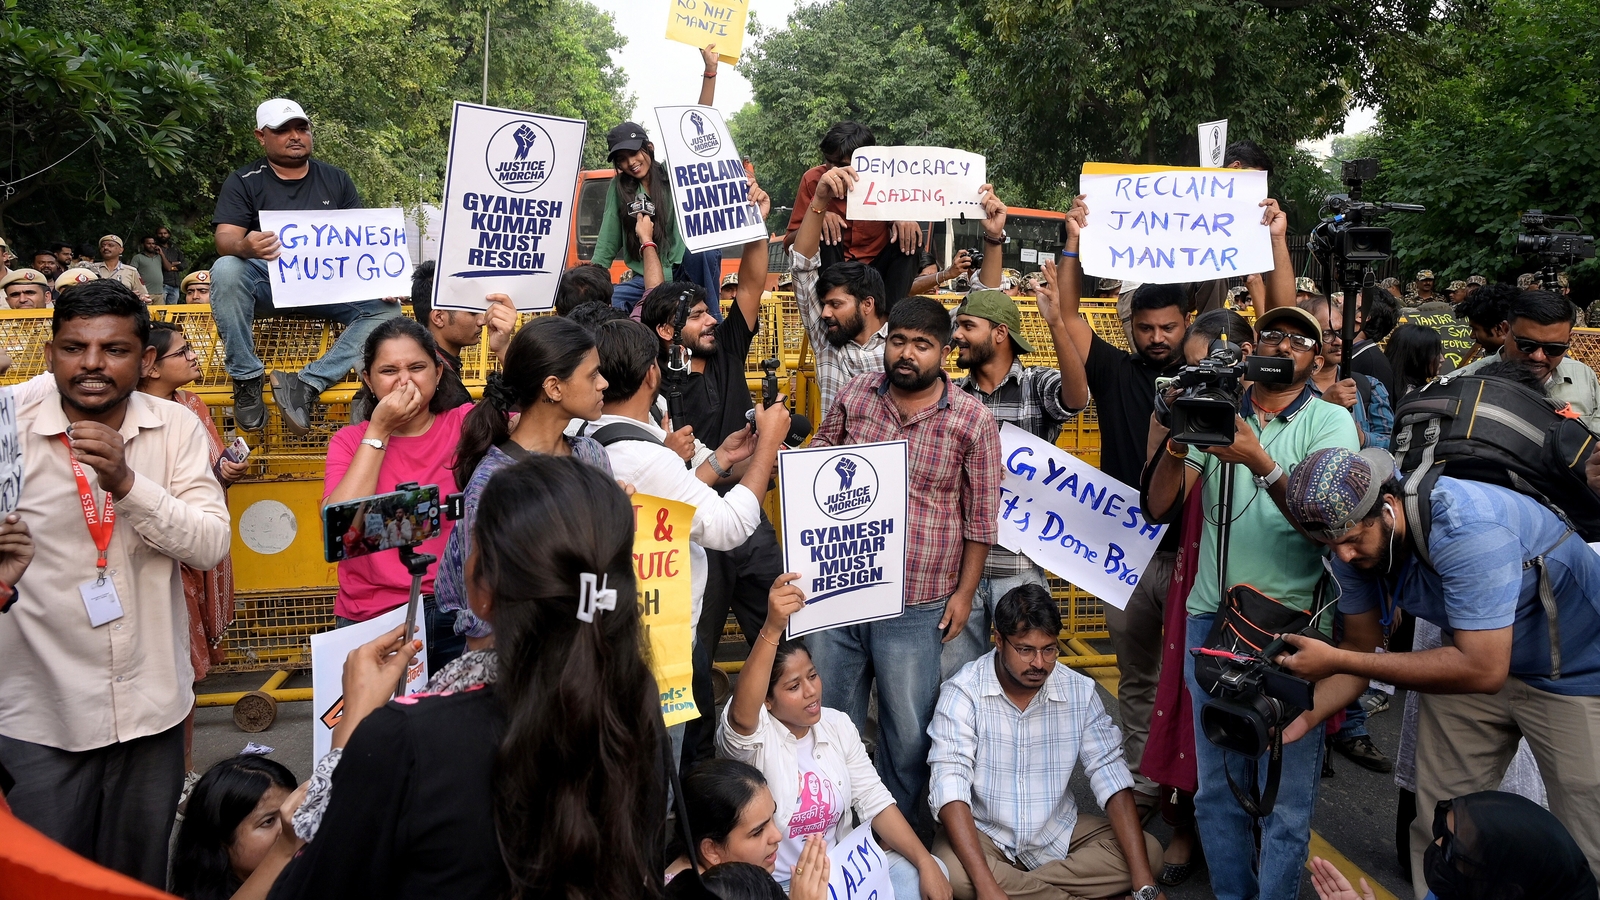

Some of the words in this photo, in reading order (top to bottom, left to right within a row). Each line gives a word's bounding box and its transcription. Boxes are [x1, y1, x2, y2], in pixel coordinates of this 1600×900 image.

[703, 1, 738, 22] NHI
[676, 13, 727, 36] MANTI
[690, 132, 716, 146] JUSTICE
[694, 140, 719, 152] MORCHA
[495, 160, 546, 172] JUSTICE
[498, 171, 544, 181] MORCHA
[674, 159, 747, 187] RECLAIM
[855, 156, 970, 177] DEMOCRACY
[682, 180, 750, 213] JANTAR
[1115, 175, 1234, 201] RECLAIM
[463, 192, 562, 218] GYANESH
[471, 212, 552, 235] KUMAR
[684, 204, 762, 238] MANTAR
[1107, 210, 1234, 237] JANTAR
[279, 223, 406, 249] GYANESH
[478, 232, 542, 252] MUST
[278, 255, 350, 283] MUST
[357, 252, 405, 280] GO
[468, 248, 545, 269] RESIGN
[1109, 246, 1238, 271] MANTAR
[1408, 314, 1456, 326] JANTAR
[823, 485, 871, 506] JUSTICE
[828, 495, 871, 514] MORCHA
[1006, 446, 1163, 540] GYANESH
[81, 493, 98, 525] PRESS
[654, 507, 673, 542] &
[800, 518, 894, 546] GYANESH
[810, 535, 885, 562] KUMAR
[1038, 510, 1098, 564] Done
[1103, 542, 1139, 586] Bro
[819, 553, 877, 576] MUST
[812, 567, 883, 593] RESIGN
